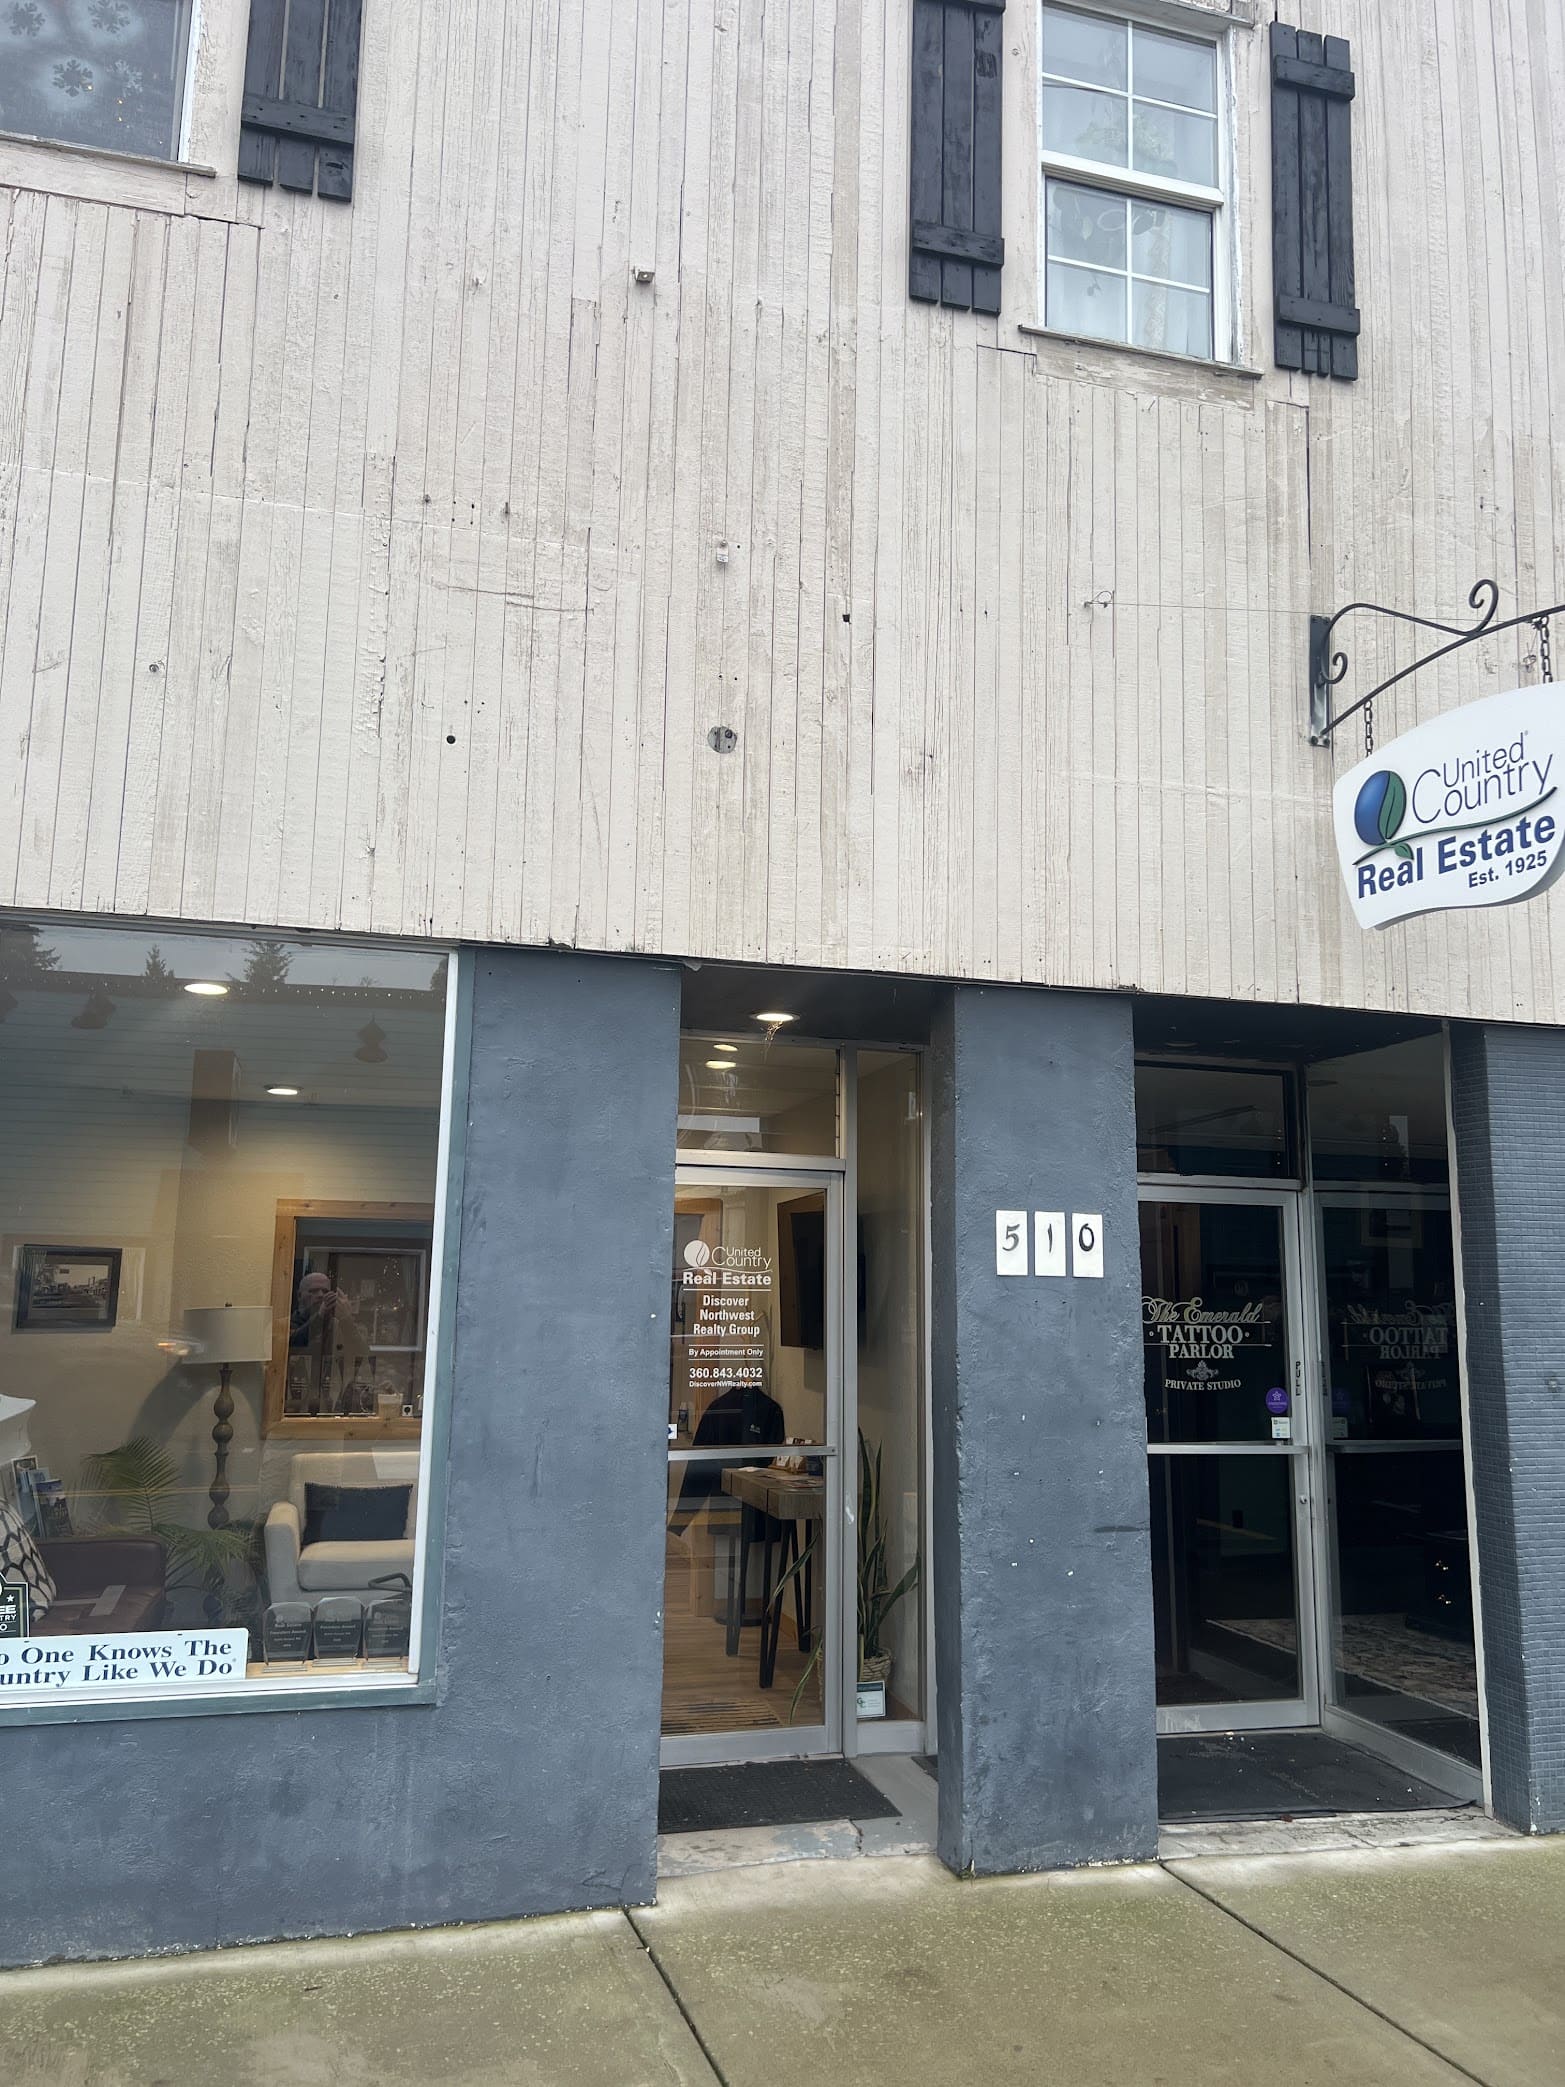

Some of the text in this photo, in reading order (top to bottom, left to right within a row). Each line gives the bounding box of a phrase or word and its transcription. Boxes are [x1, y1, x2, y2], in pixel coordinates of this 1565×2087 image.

[1443, 731, 1524, 788] United
[1412, 753, 1554, 824] Country
[1358, 815, 1556, 899] Real Estate
[1468, 849, 1548, 888] Est. 1925
[1002, 1223, 1095, 1253] 510
[711, 1246, 772, 1270] Country
[726, 1246, 761, 1257] United
[682, 1271, 772, 1285] Real Estate
[702, 1294, 750, 1306] Discover
[699, 1308, 755, 1321] Northwest
[1142, 1296, 1263, 1325] The Emerald
[693, 1323, 760, 1338] Realty Group
[1157, 1324, 1244, 1344] TATTOO
[688, 1348, 764, 1358] By Appointment Only
[1168, 1344, 1235, 1359] PARLOR
[689, 1367, 763, 1379] 360.843.4032
[688, 1380, 763, 1389] DiscoverNWRealty.com
[1164, 1379, 1242, 1391] PRIVATE STUDIO
[21, 1646, 74, 1665] One
[89, 1643, 173, 1661] Knows
[184, 1639, 232, 1657] The
[82, 1664, 139, 1682] Like
[149, 1660, 187, 1678] We
[196, 1659, 233, 1676] Do
